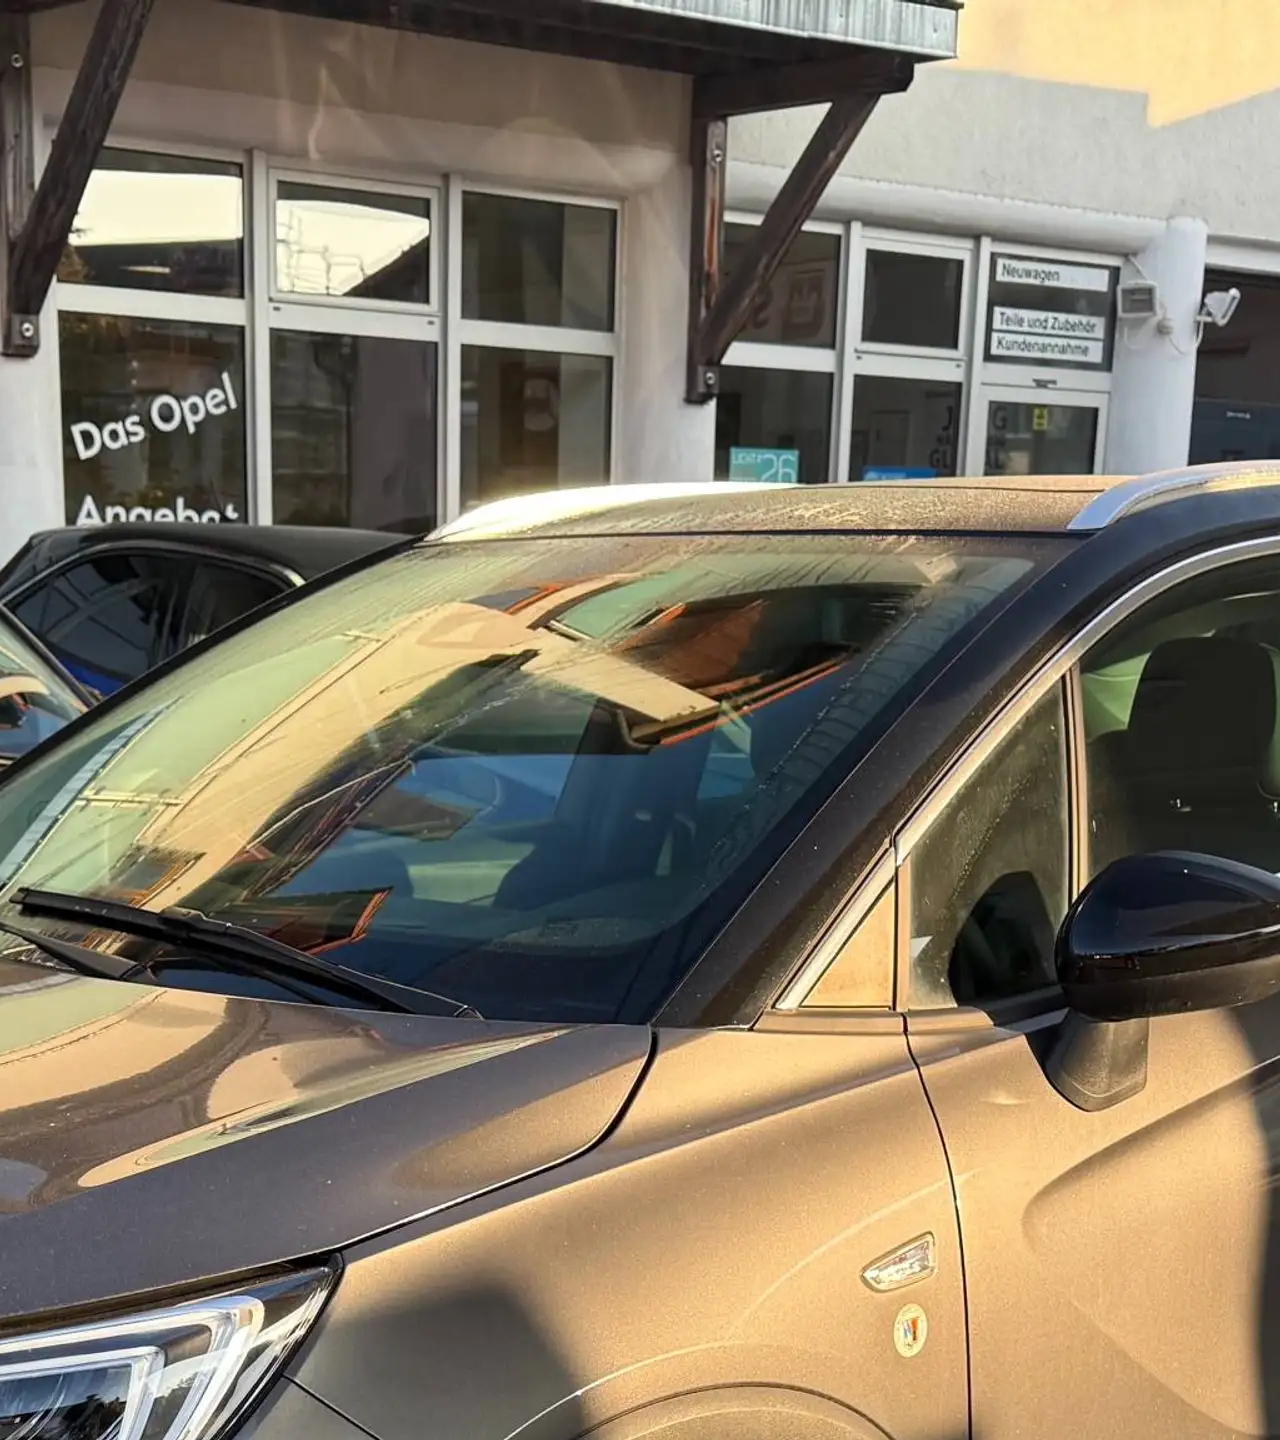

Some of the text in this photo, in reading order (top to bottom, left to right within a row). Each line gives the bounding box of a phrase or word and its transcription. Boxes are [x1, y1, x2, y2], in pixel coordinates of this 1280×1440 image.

[1001, 263, 1061, 285] Neuwagen
[1000, 311, 1025, 328] Teile
[1027, 315, 1049, 331] und
[996, 335, 1090, 357] Kundenannahme
[70, 371, 238, 460] Das Opel
